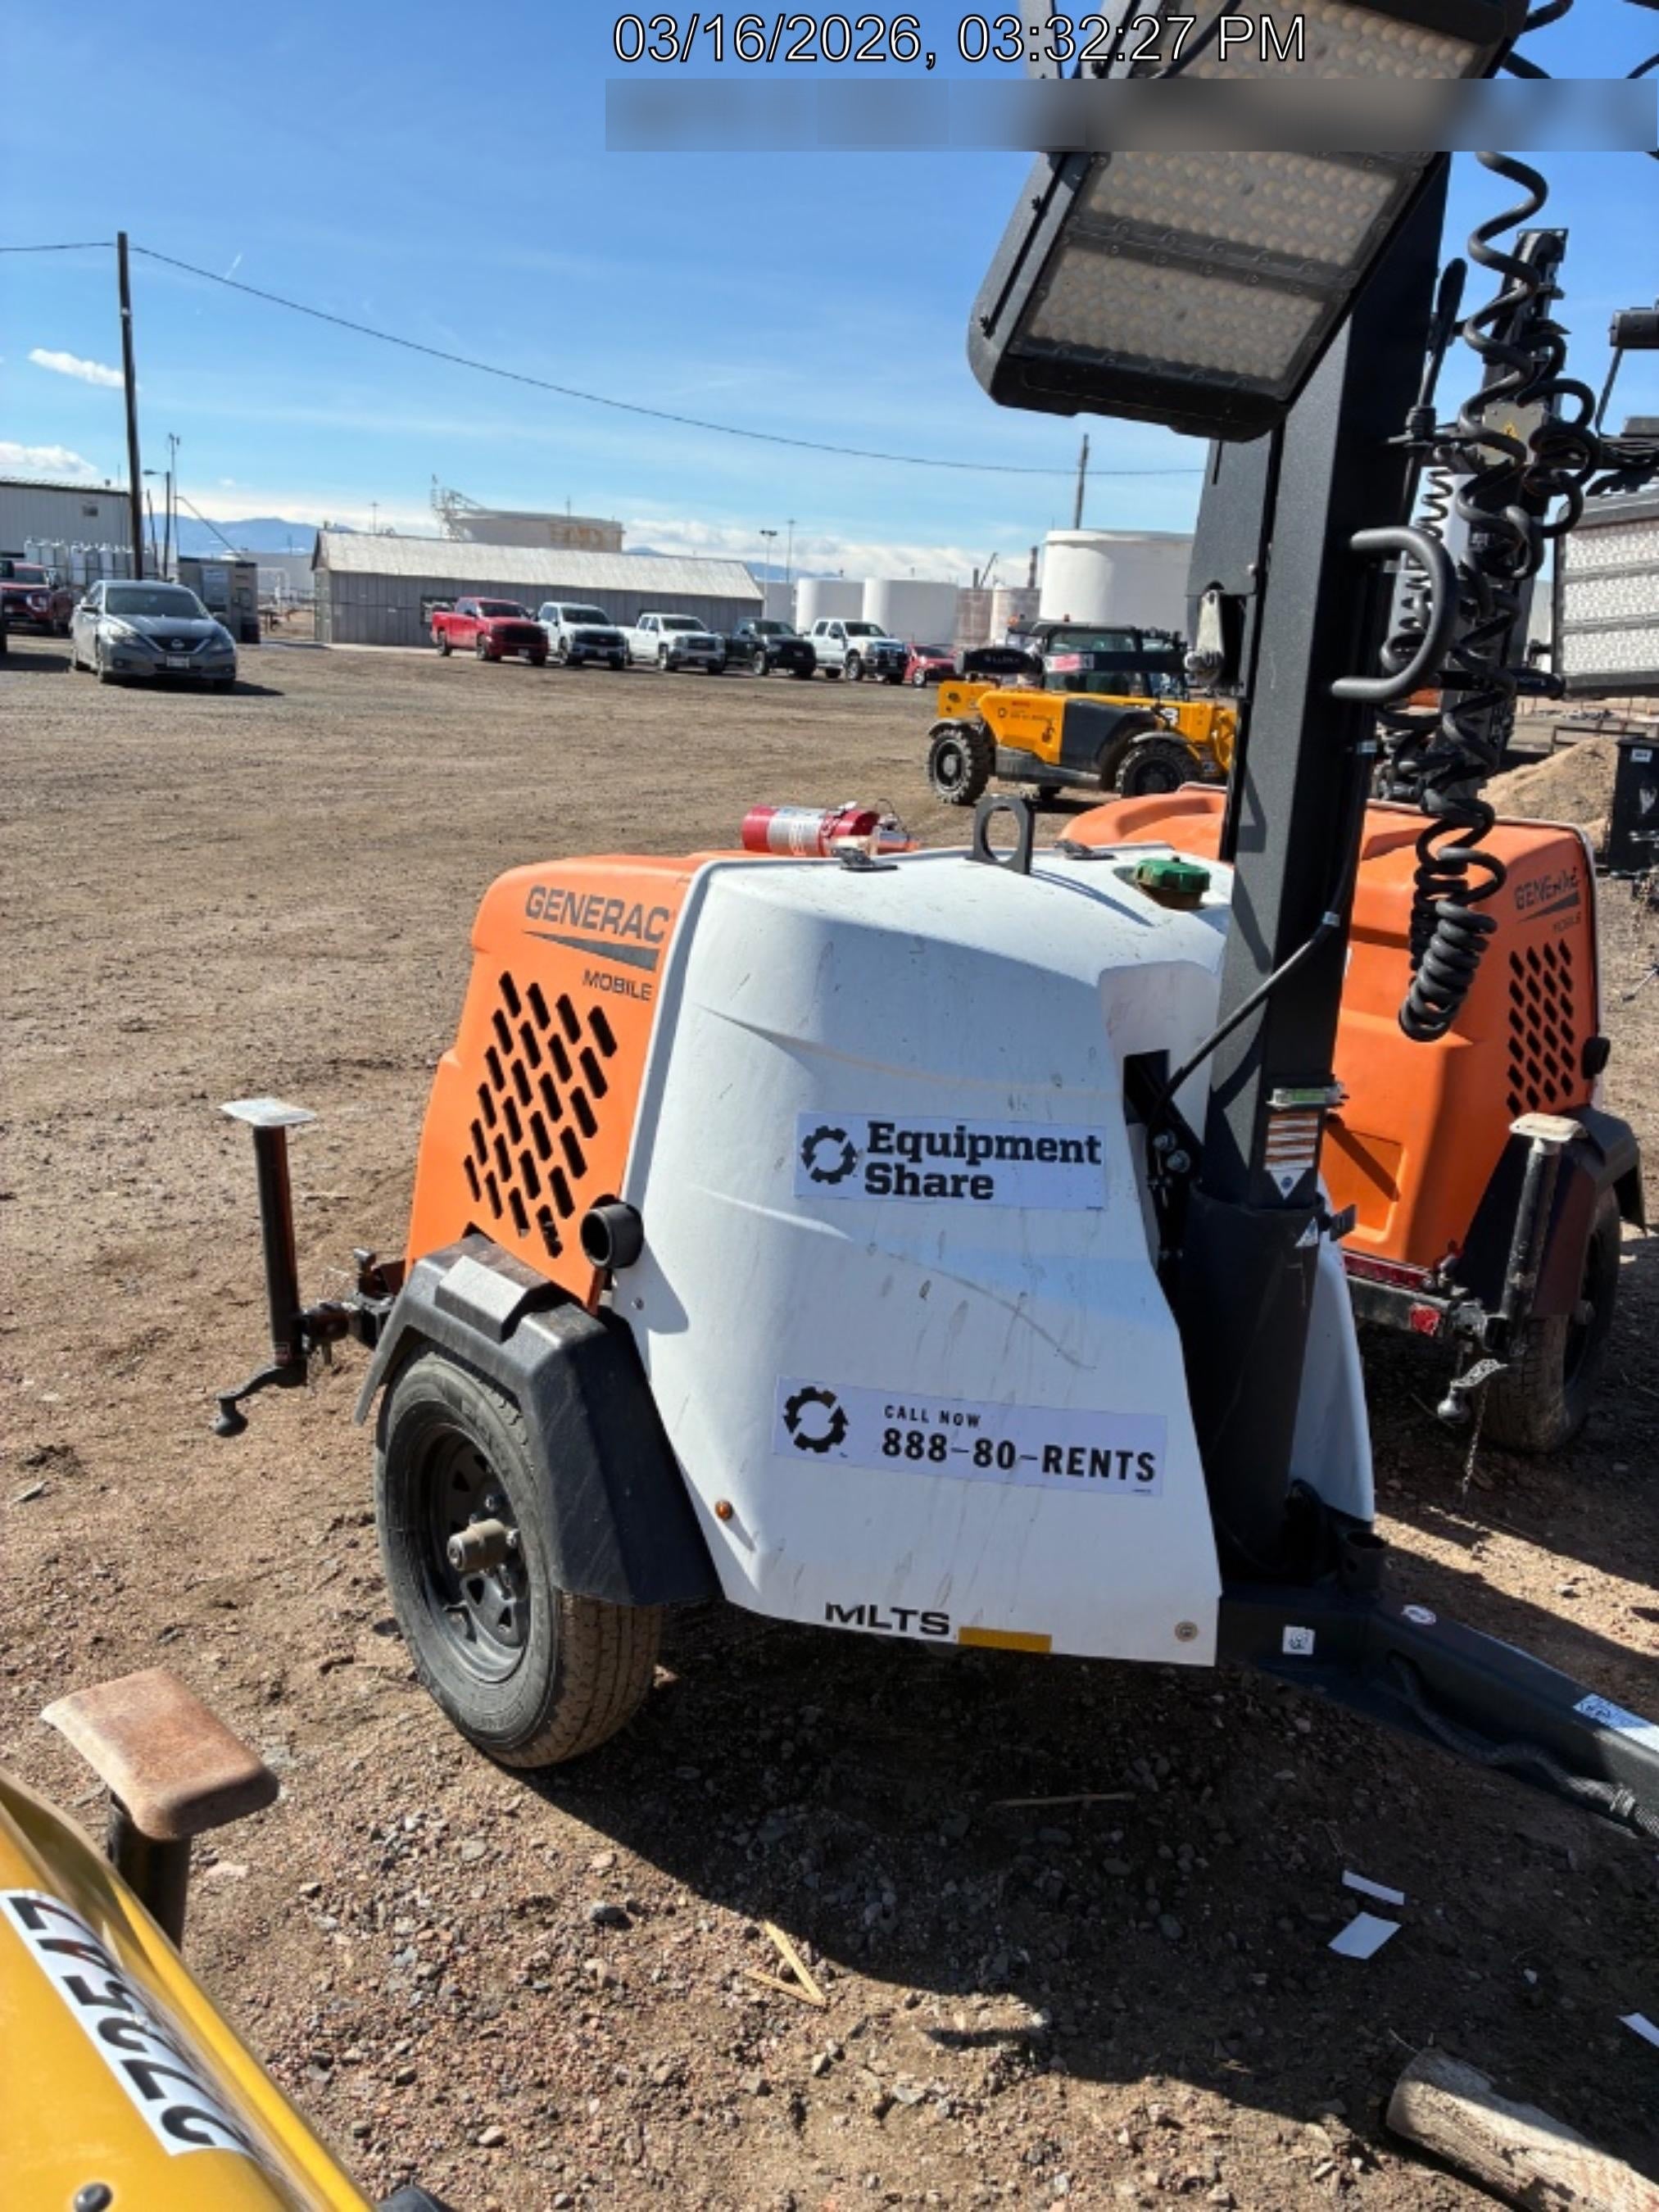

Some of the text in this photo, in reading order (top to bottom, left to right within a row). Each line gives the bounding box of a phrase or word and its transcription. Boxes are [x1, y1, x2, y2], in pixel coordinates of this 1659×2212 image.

[525, 886, 669, 943] GENERAC
[583, 970, 652, 1000] MOBILE
[867, 1121, 1101, 1166] Equipment
[863, 1162, 995, 1200] Share
[884, 1405, 981, 1429] CALL NOW
[882, 1427, 1156, 1483] 888-80-RENTS
[826, 1602, 950, 1634] MLTS
